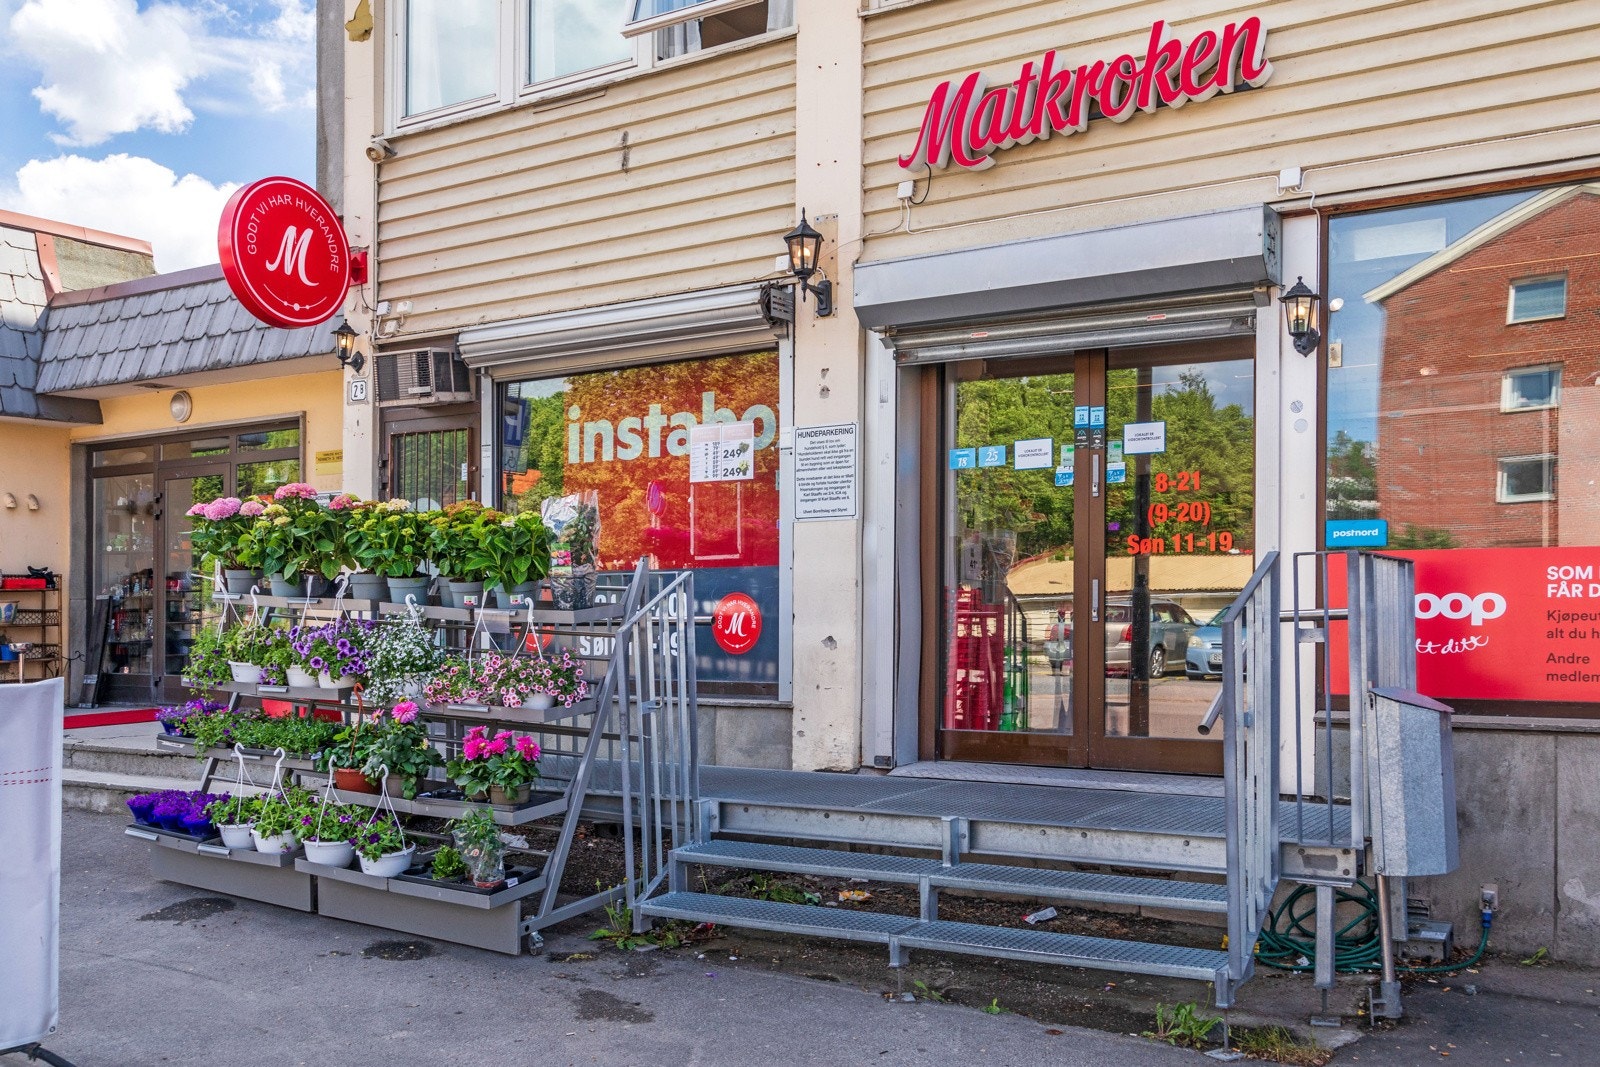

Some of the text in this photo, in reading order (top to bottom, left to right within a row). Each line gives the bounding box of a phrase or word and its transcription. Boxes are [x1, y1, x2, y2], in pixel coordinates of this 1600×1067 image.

[898, 16, 1270, 169] Matkroken
[246, 194, 339, 274] GODT VI HAR HVERANDRE
[265, 225, 320, 286] M
[568, 392, 779, 464] instabo
[798, 428, 854, 438] HUNDEPARKERING
[723, 449, 742, 458] 249
[986, 451, 998, 462] 25
[958, 458, 968, 467] 18
[723, 468, 742, 477] 249
[1155, 470, 1200, 493] 8-21
[1147, 501, 1211, 528] (9-20)
[1333, 528, 1378, 538] postnord
[1127, 532, 1233, 554] Søn 11-19
[1546, 566, 1593, 580] SOM
[1547, 581, 1584, 598] FÅR
[1414, 592, 1507, 626] oop
[724, 612, 747, 637] M
[1546, 628, 1564, 639] alt
[1568, 628, 1586, 639] du
[1546, 652, 1590, 664] Andre
